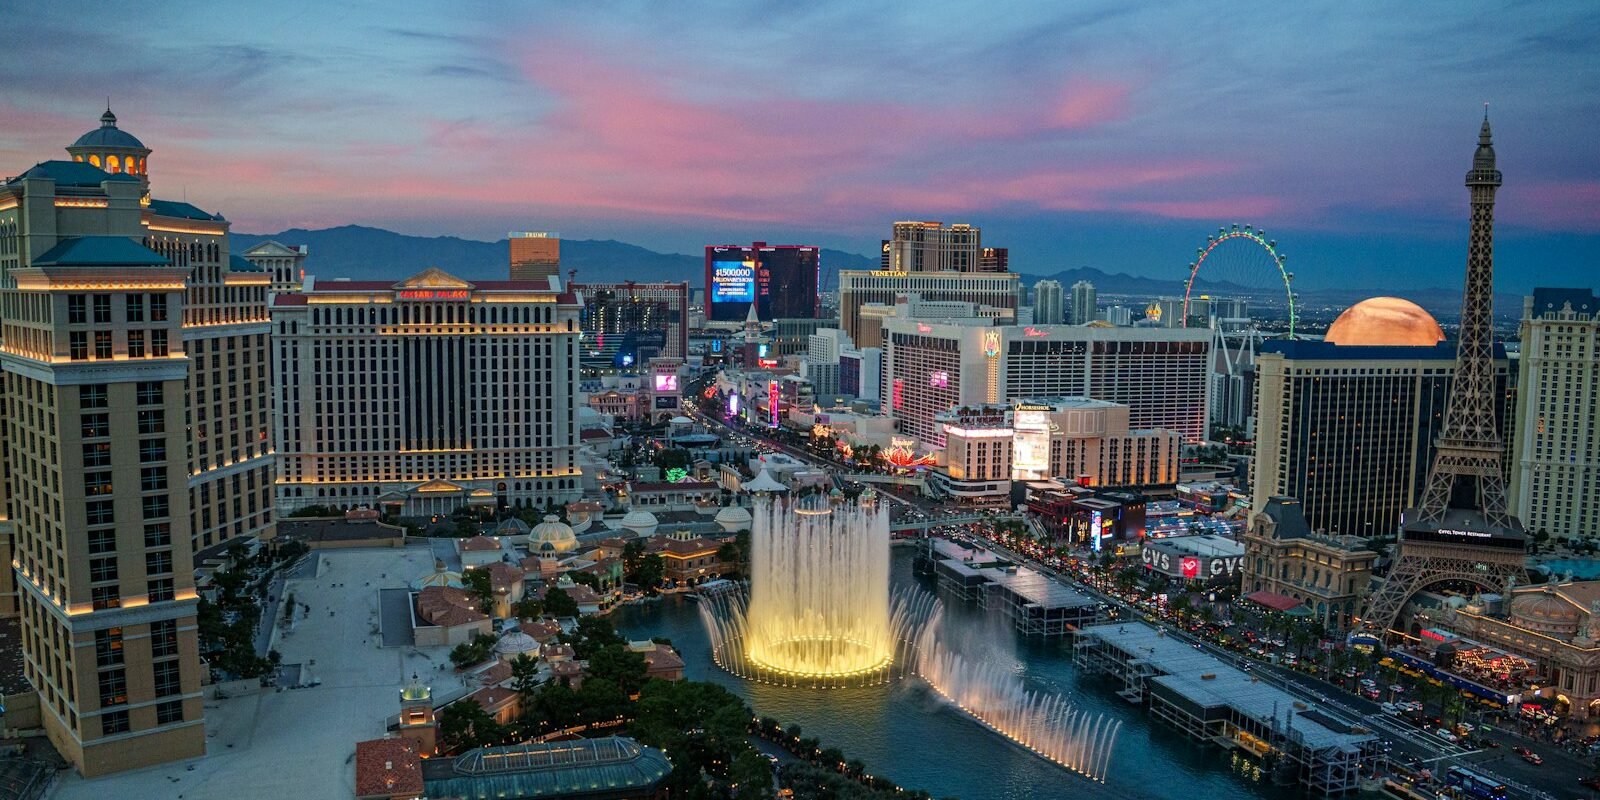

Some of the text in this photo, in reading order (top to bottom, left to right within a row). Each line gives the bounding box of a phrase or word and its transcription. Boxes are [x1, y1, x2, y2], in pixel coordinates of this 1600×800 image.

[399, 290, 468, 299] CAESARS PALACE
[1142, 547, 1170, 571] CVS
